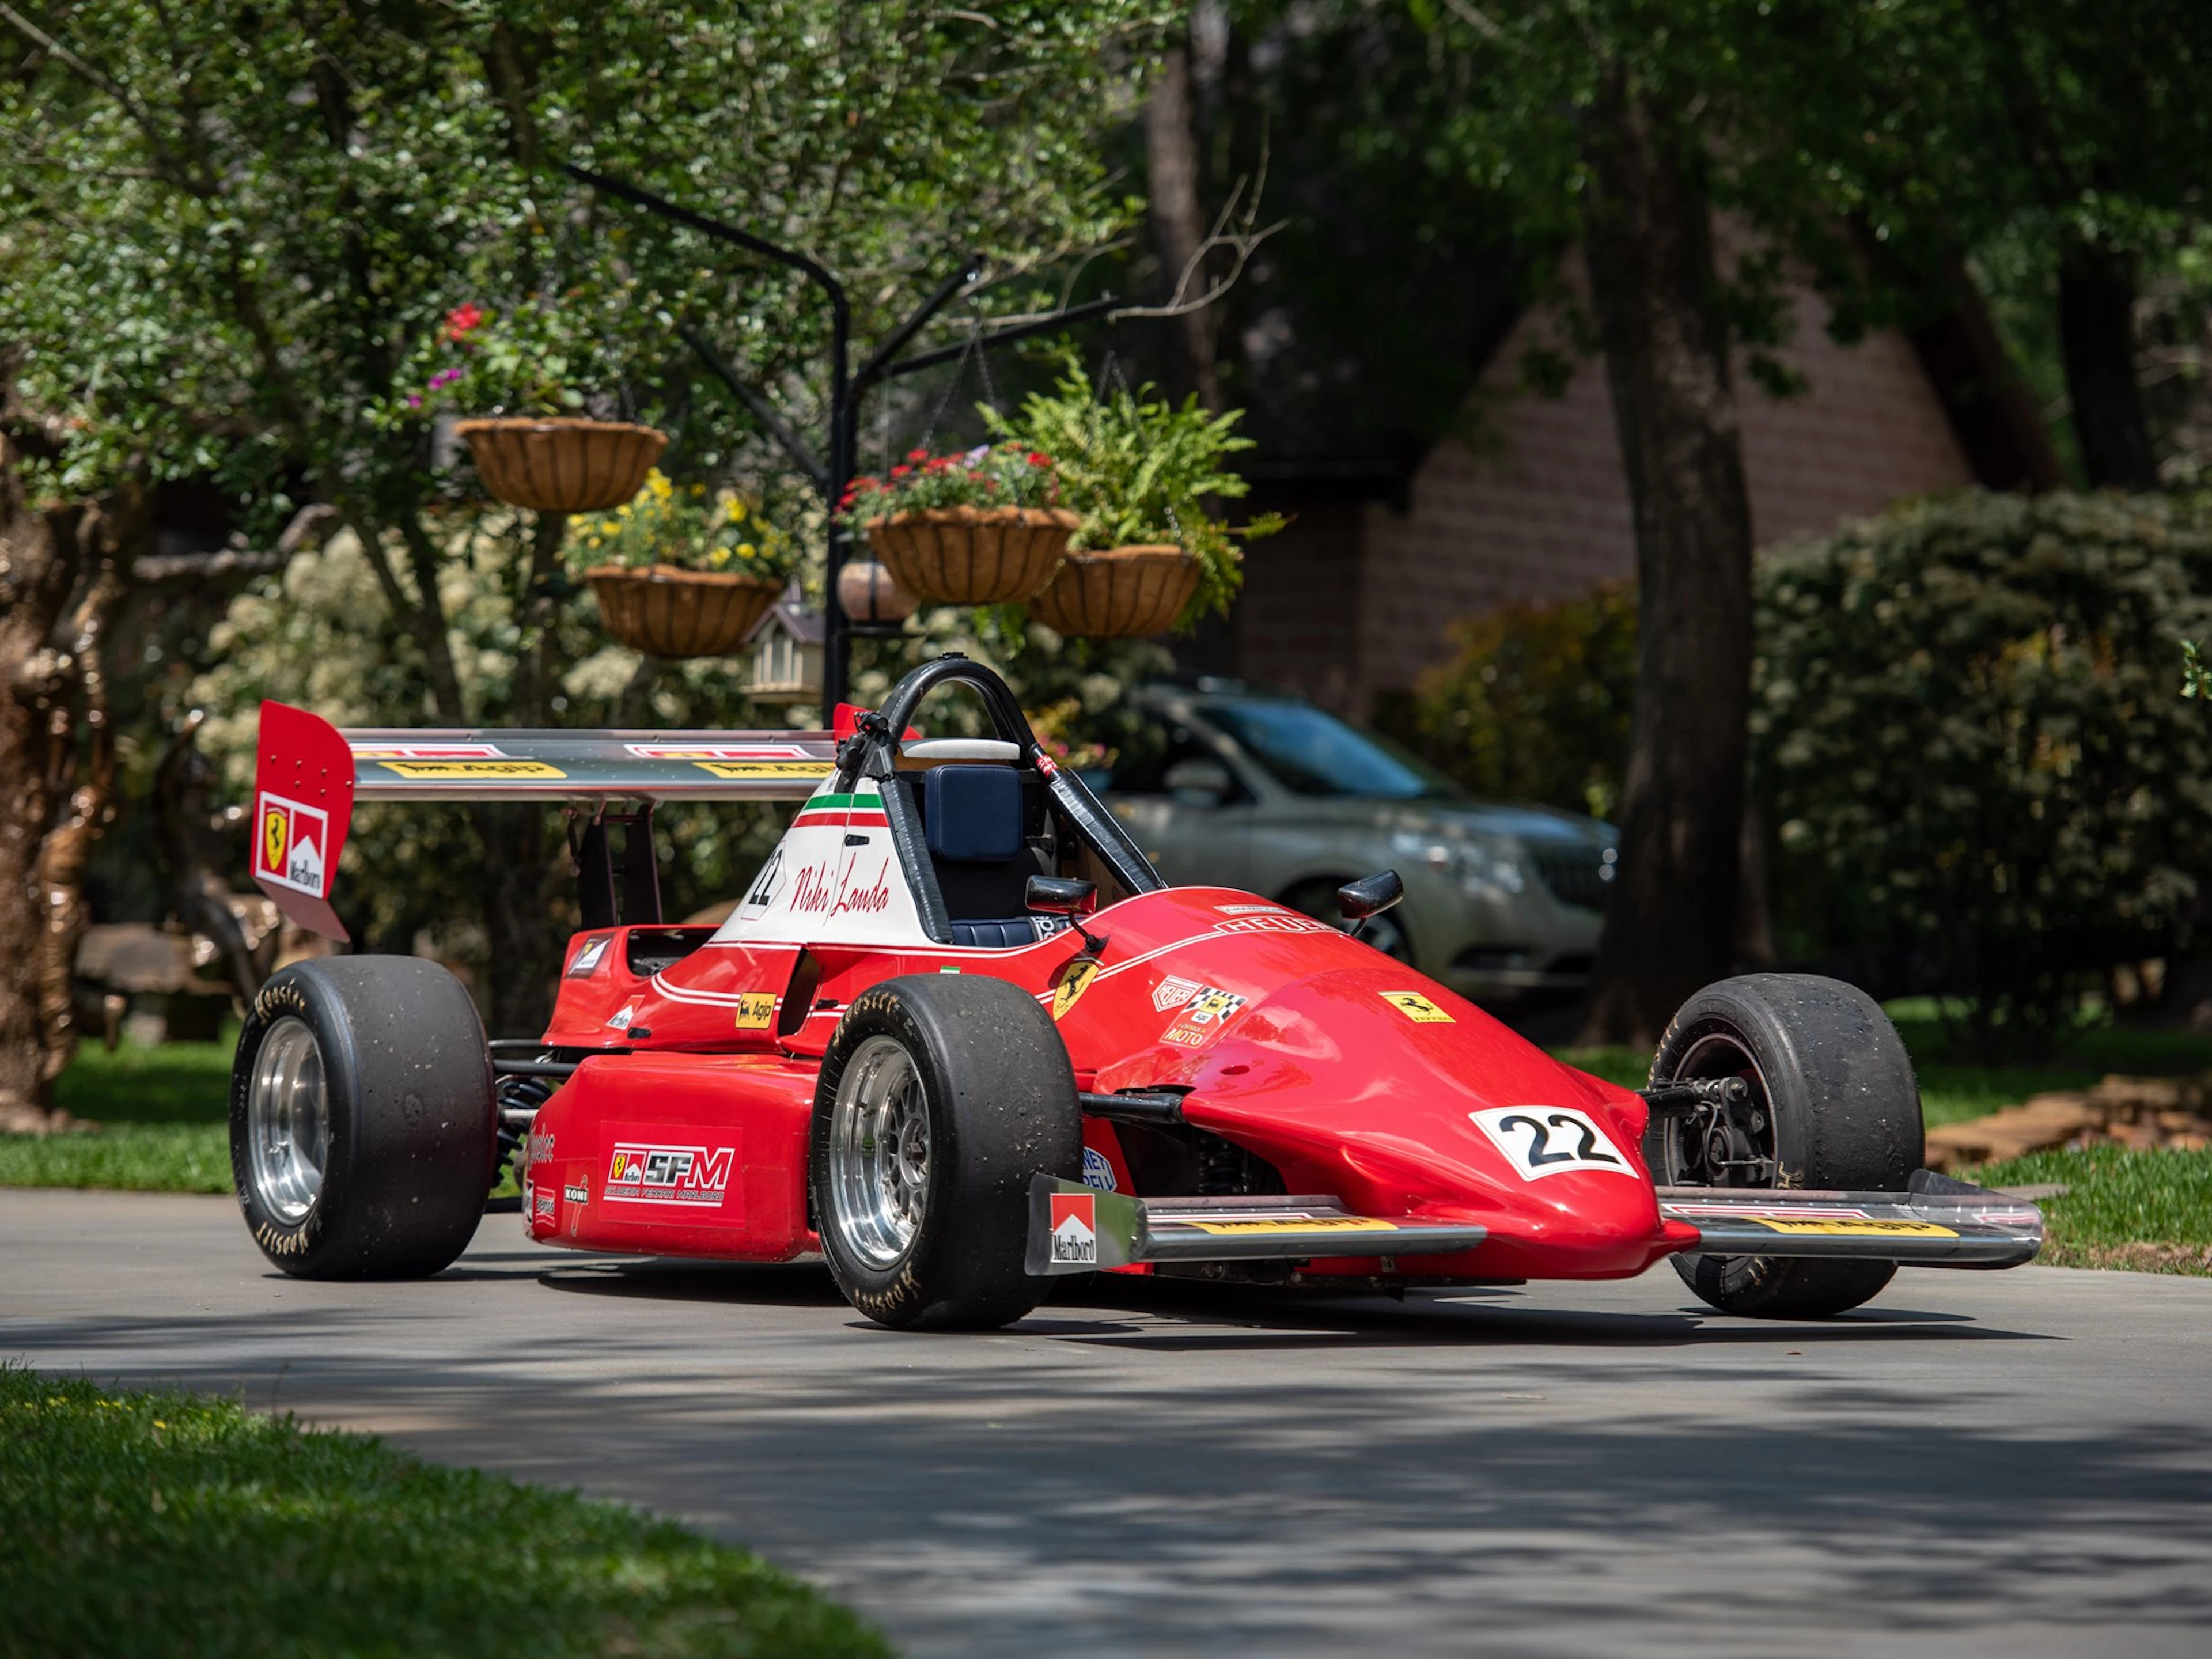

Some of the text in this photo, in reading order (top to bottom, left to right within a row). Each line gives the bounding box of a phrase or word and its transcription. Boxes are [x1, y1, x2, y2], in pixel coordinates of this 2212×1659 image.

[748, 849, 783, 906] 22
[790, 851, 890, 918] Niki Lauda
[255, 978, 306, 1024] Hoosier
[752, 999, 771, 1021] Agip
[1164, 1028, 1203, 1045] MOTO
[1499, 1114, 1622, 1168] 22
[642, 1146, 736, 1190] SFM
[565, 1188, 588, 1202] KONI
[605, 1185, 725, 1201] SCUDERIA FERRARI MARLBORO
[1054, 1235, 1094, 1260] Marlboro
